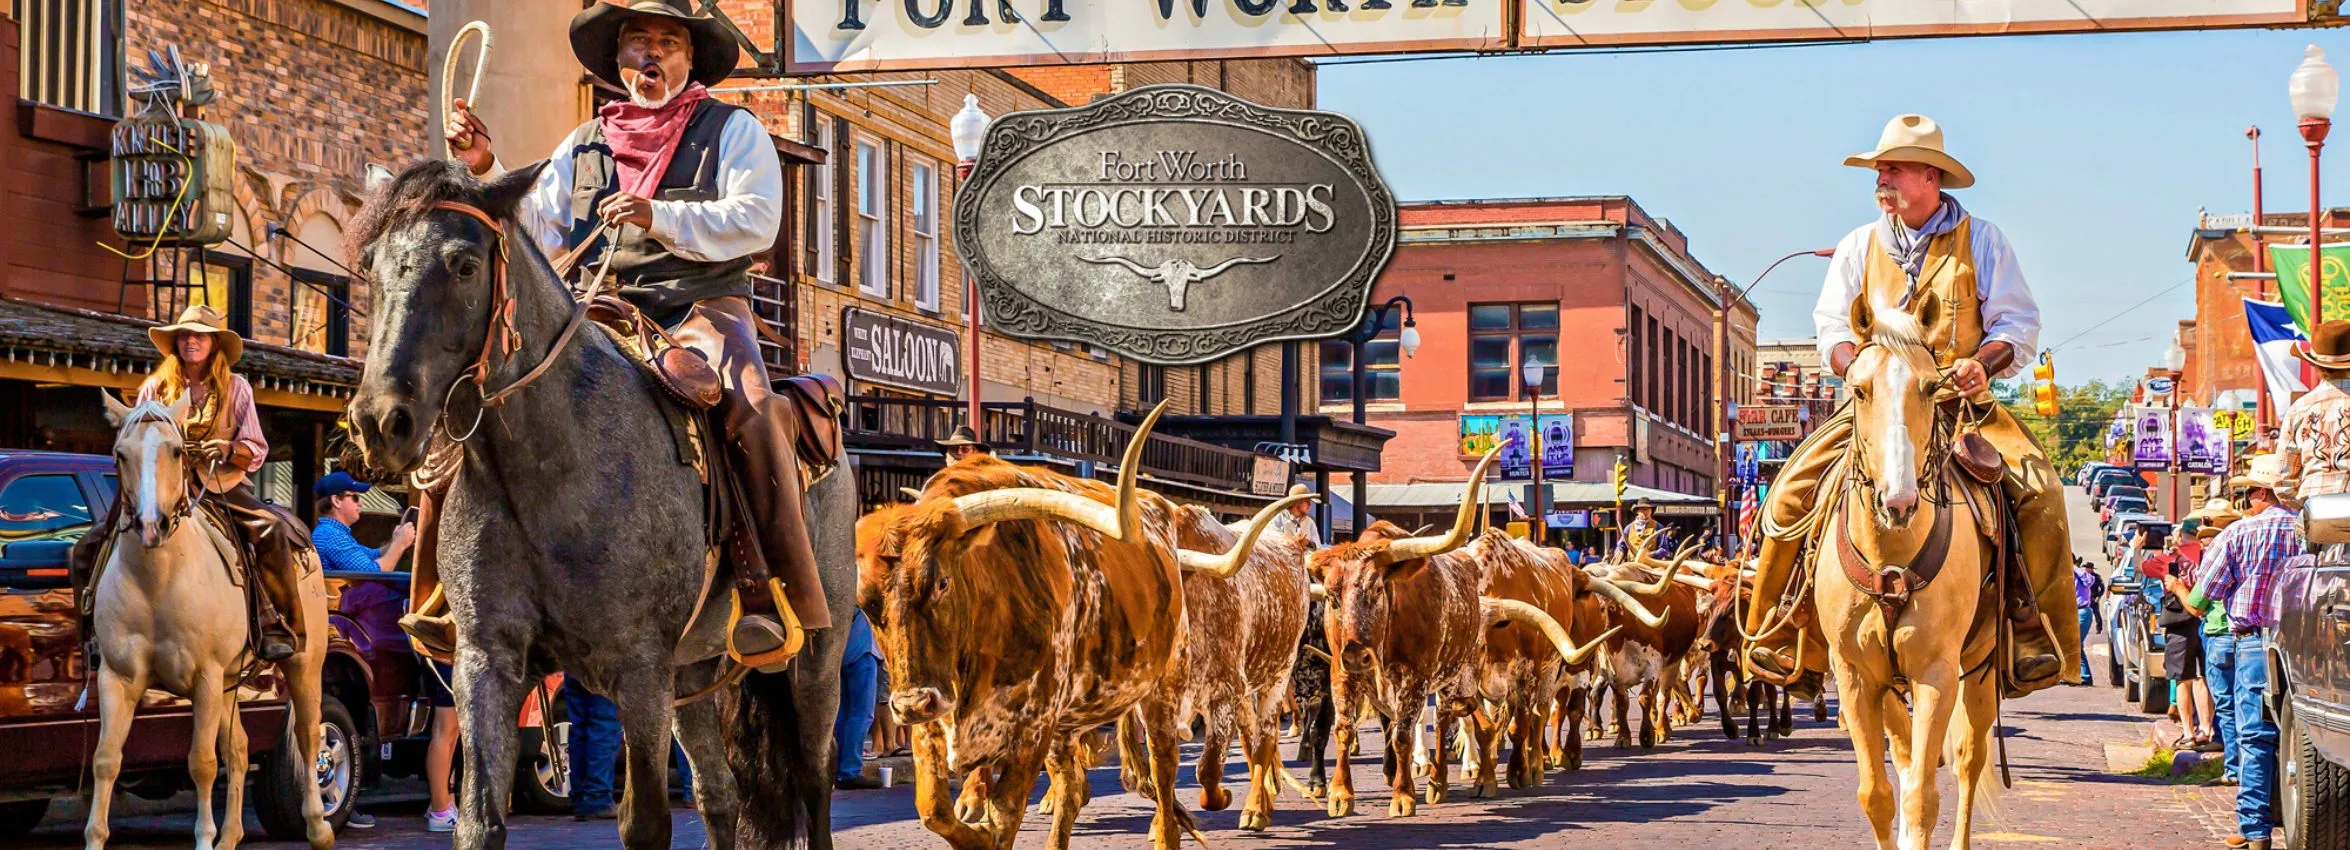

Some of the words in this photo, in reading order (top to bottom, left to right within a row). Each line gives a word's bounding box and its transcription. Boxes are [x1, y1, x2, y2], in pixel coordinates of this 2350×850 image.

[871, 323, 938, 383] SALOON
[1739, 409, 1766, 425] STAR
[1771, 409, 1798, 424] CAFE
